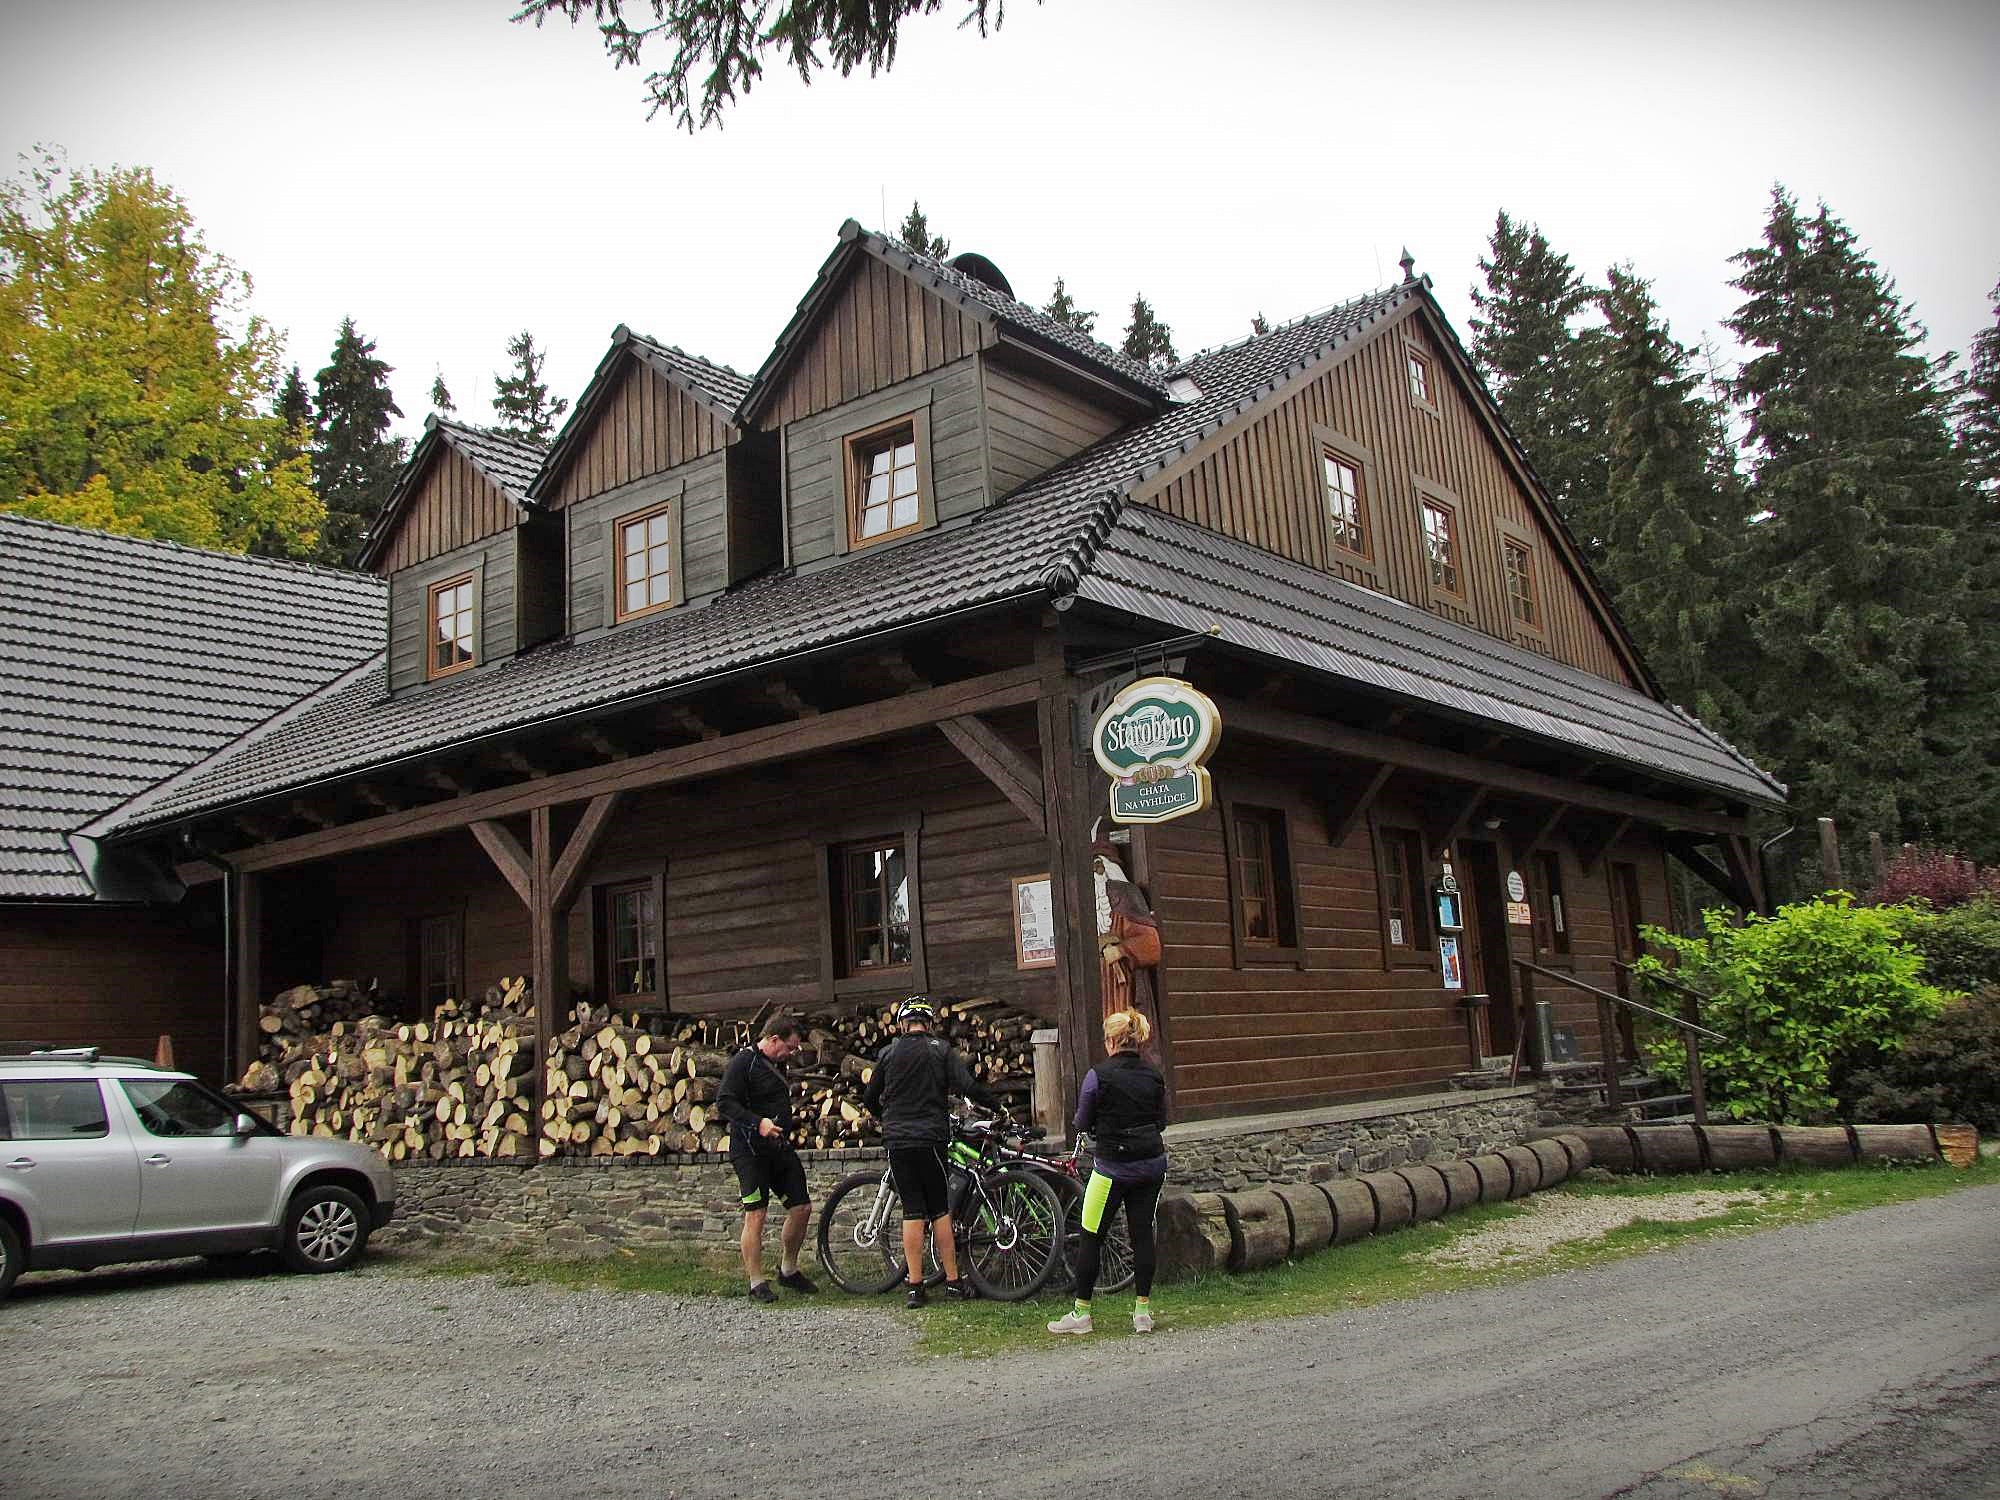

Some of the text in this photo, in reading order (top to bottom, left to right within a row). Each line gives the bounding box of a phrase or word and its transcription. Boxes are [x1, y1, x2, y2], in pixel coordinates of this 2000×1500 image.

[1107, 714, 1195, 752] Starobrno
[1139, 784, 1170, 796] CHATA
[1124, 793, 1186, 811] NA VYHLÍDCE
